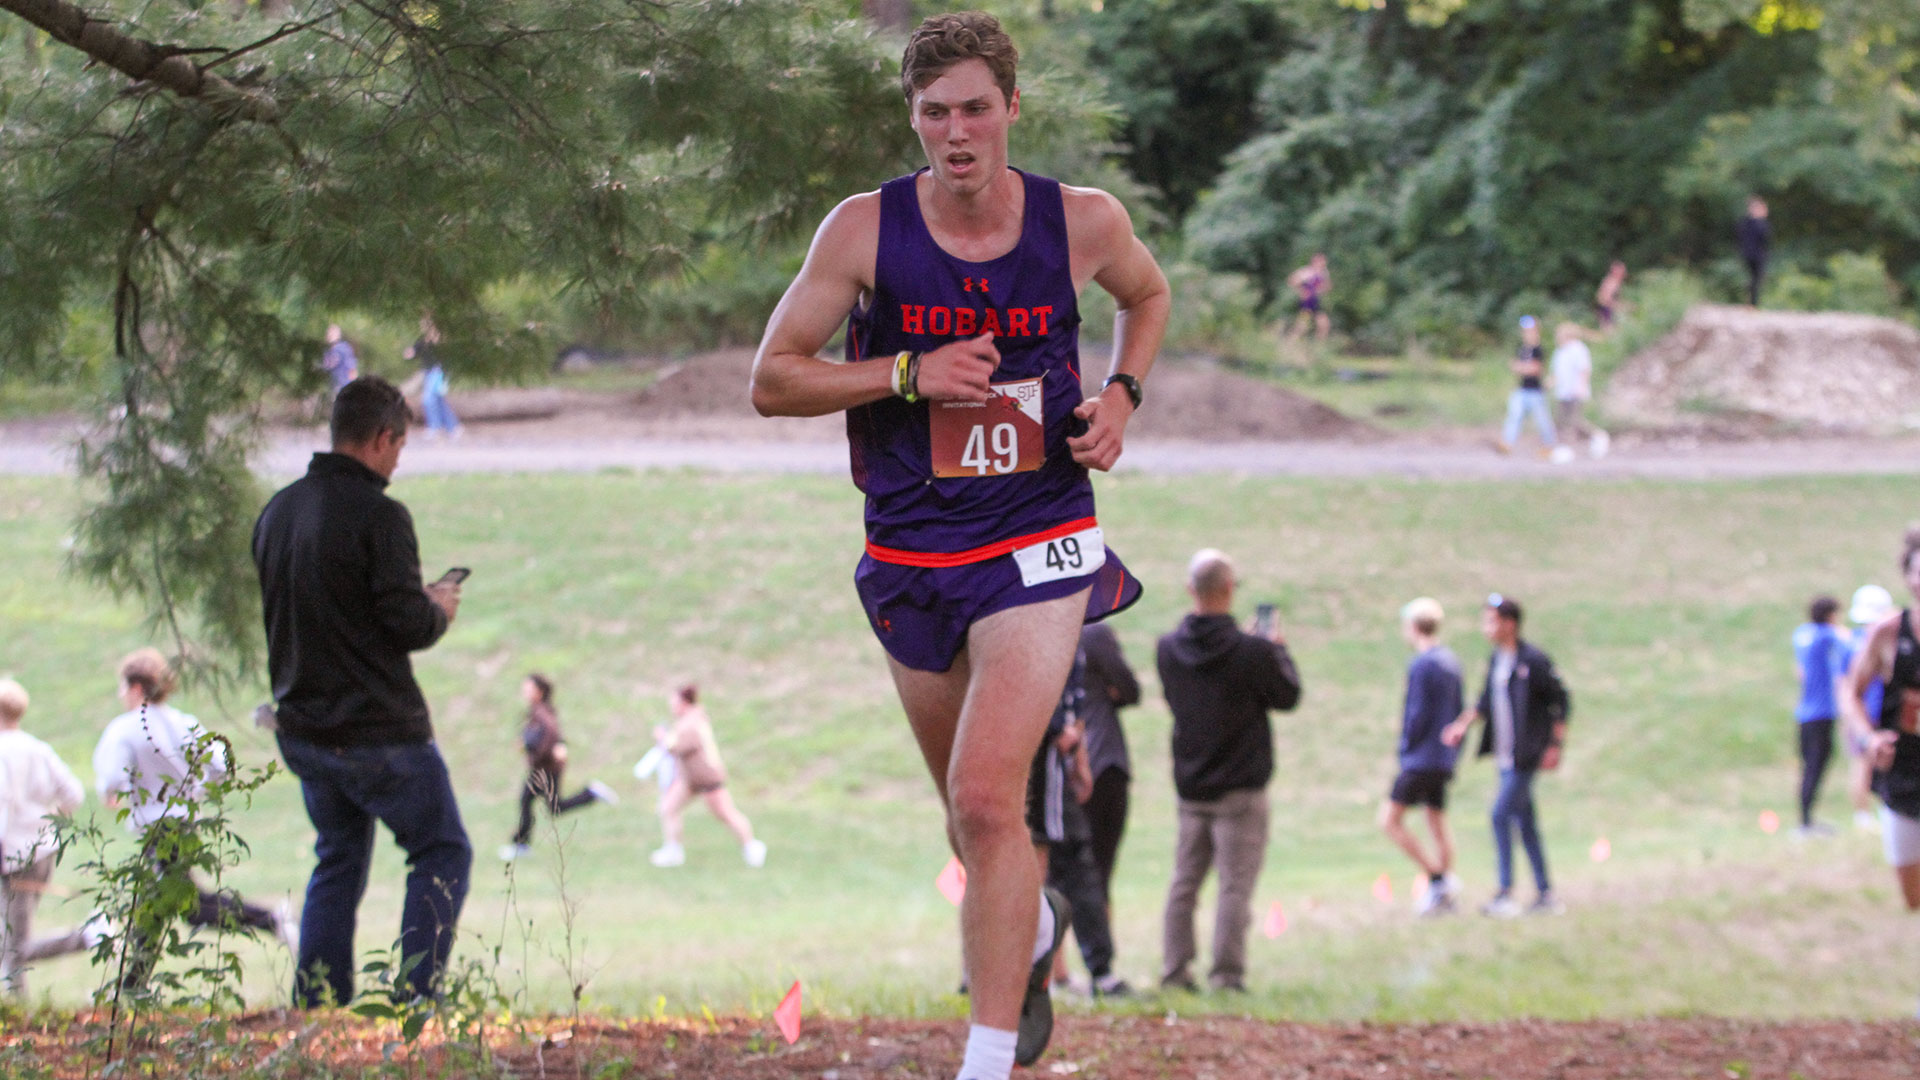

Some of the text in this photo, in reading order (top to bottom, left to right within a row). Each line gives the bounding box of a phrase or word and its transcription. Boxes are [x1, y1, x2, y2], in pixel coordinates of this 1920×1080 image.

[900, 304, 1053, 337] HOBART
[960, 422, 1019, 476] 49
[1045, 537, 1083, 572] 49
